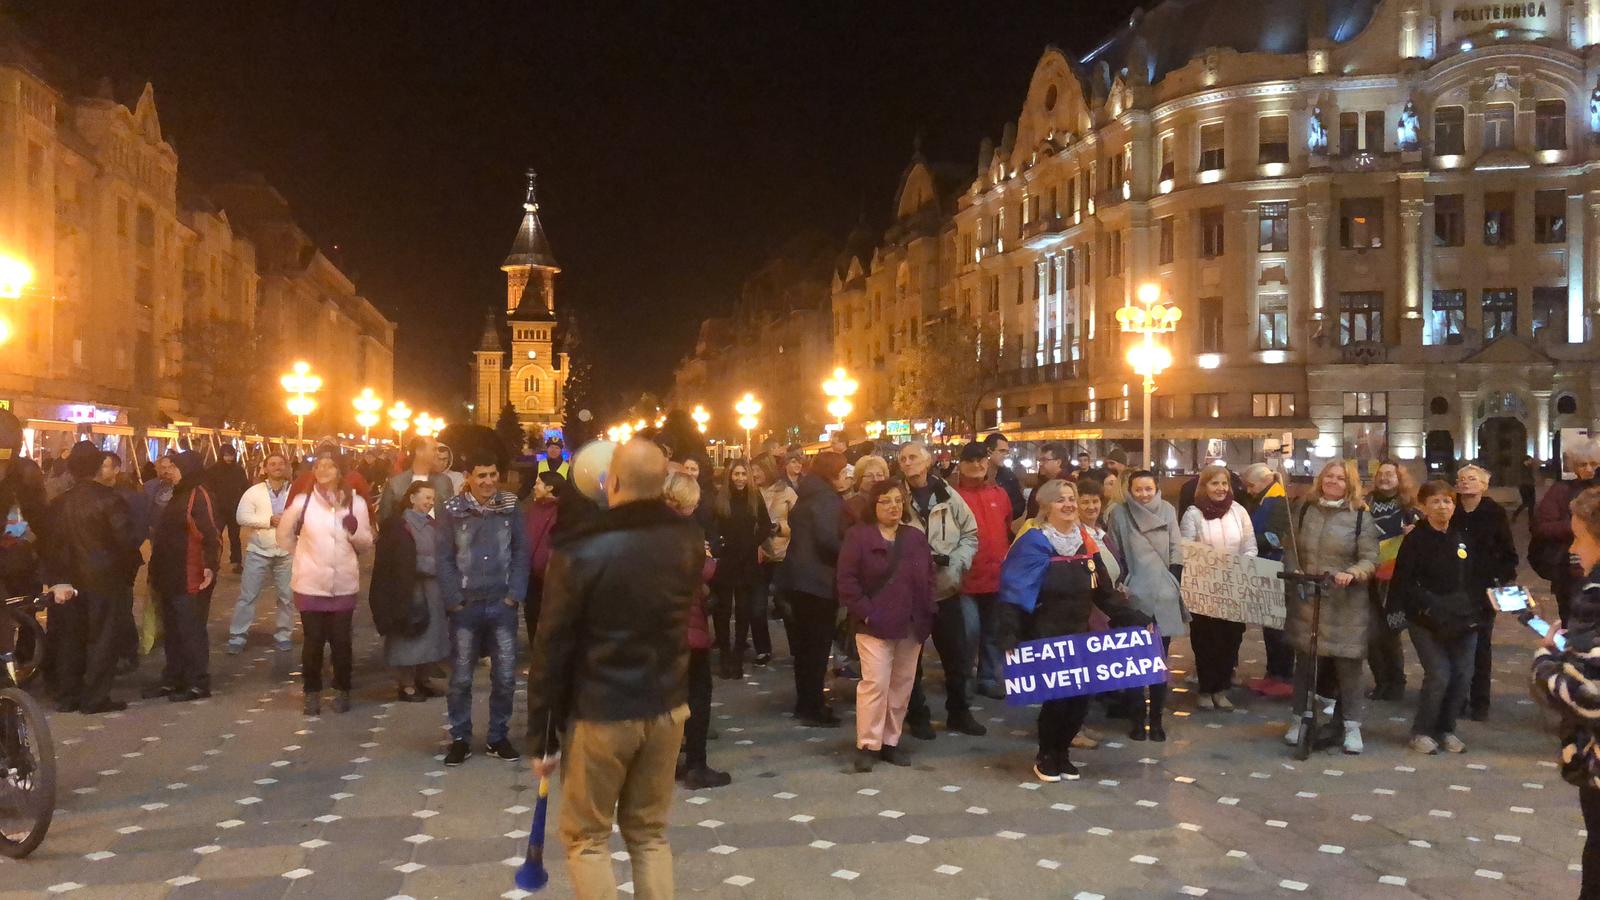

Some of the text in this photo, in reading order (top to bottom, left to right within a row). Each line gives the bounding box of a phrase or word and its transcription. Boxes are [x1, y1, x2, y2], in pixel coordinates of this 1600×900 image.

[1453, 2, 1546, 21] POLITEHNICA
[1086, 630, 1153, 652] GAZAT
[1005, 656, 1167, 695] NU VEȚI SCĂPA
